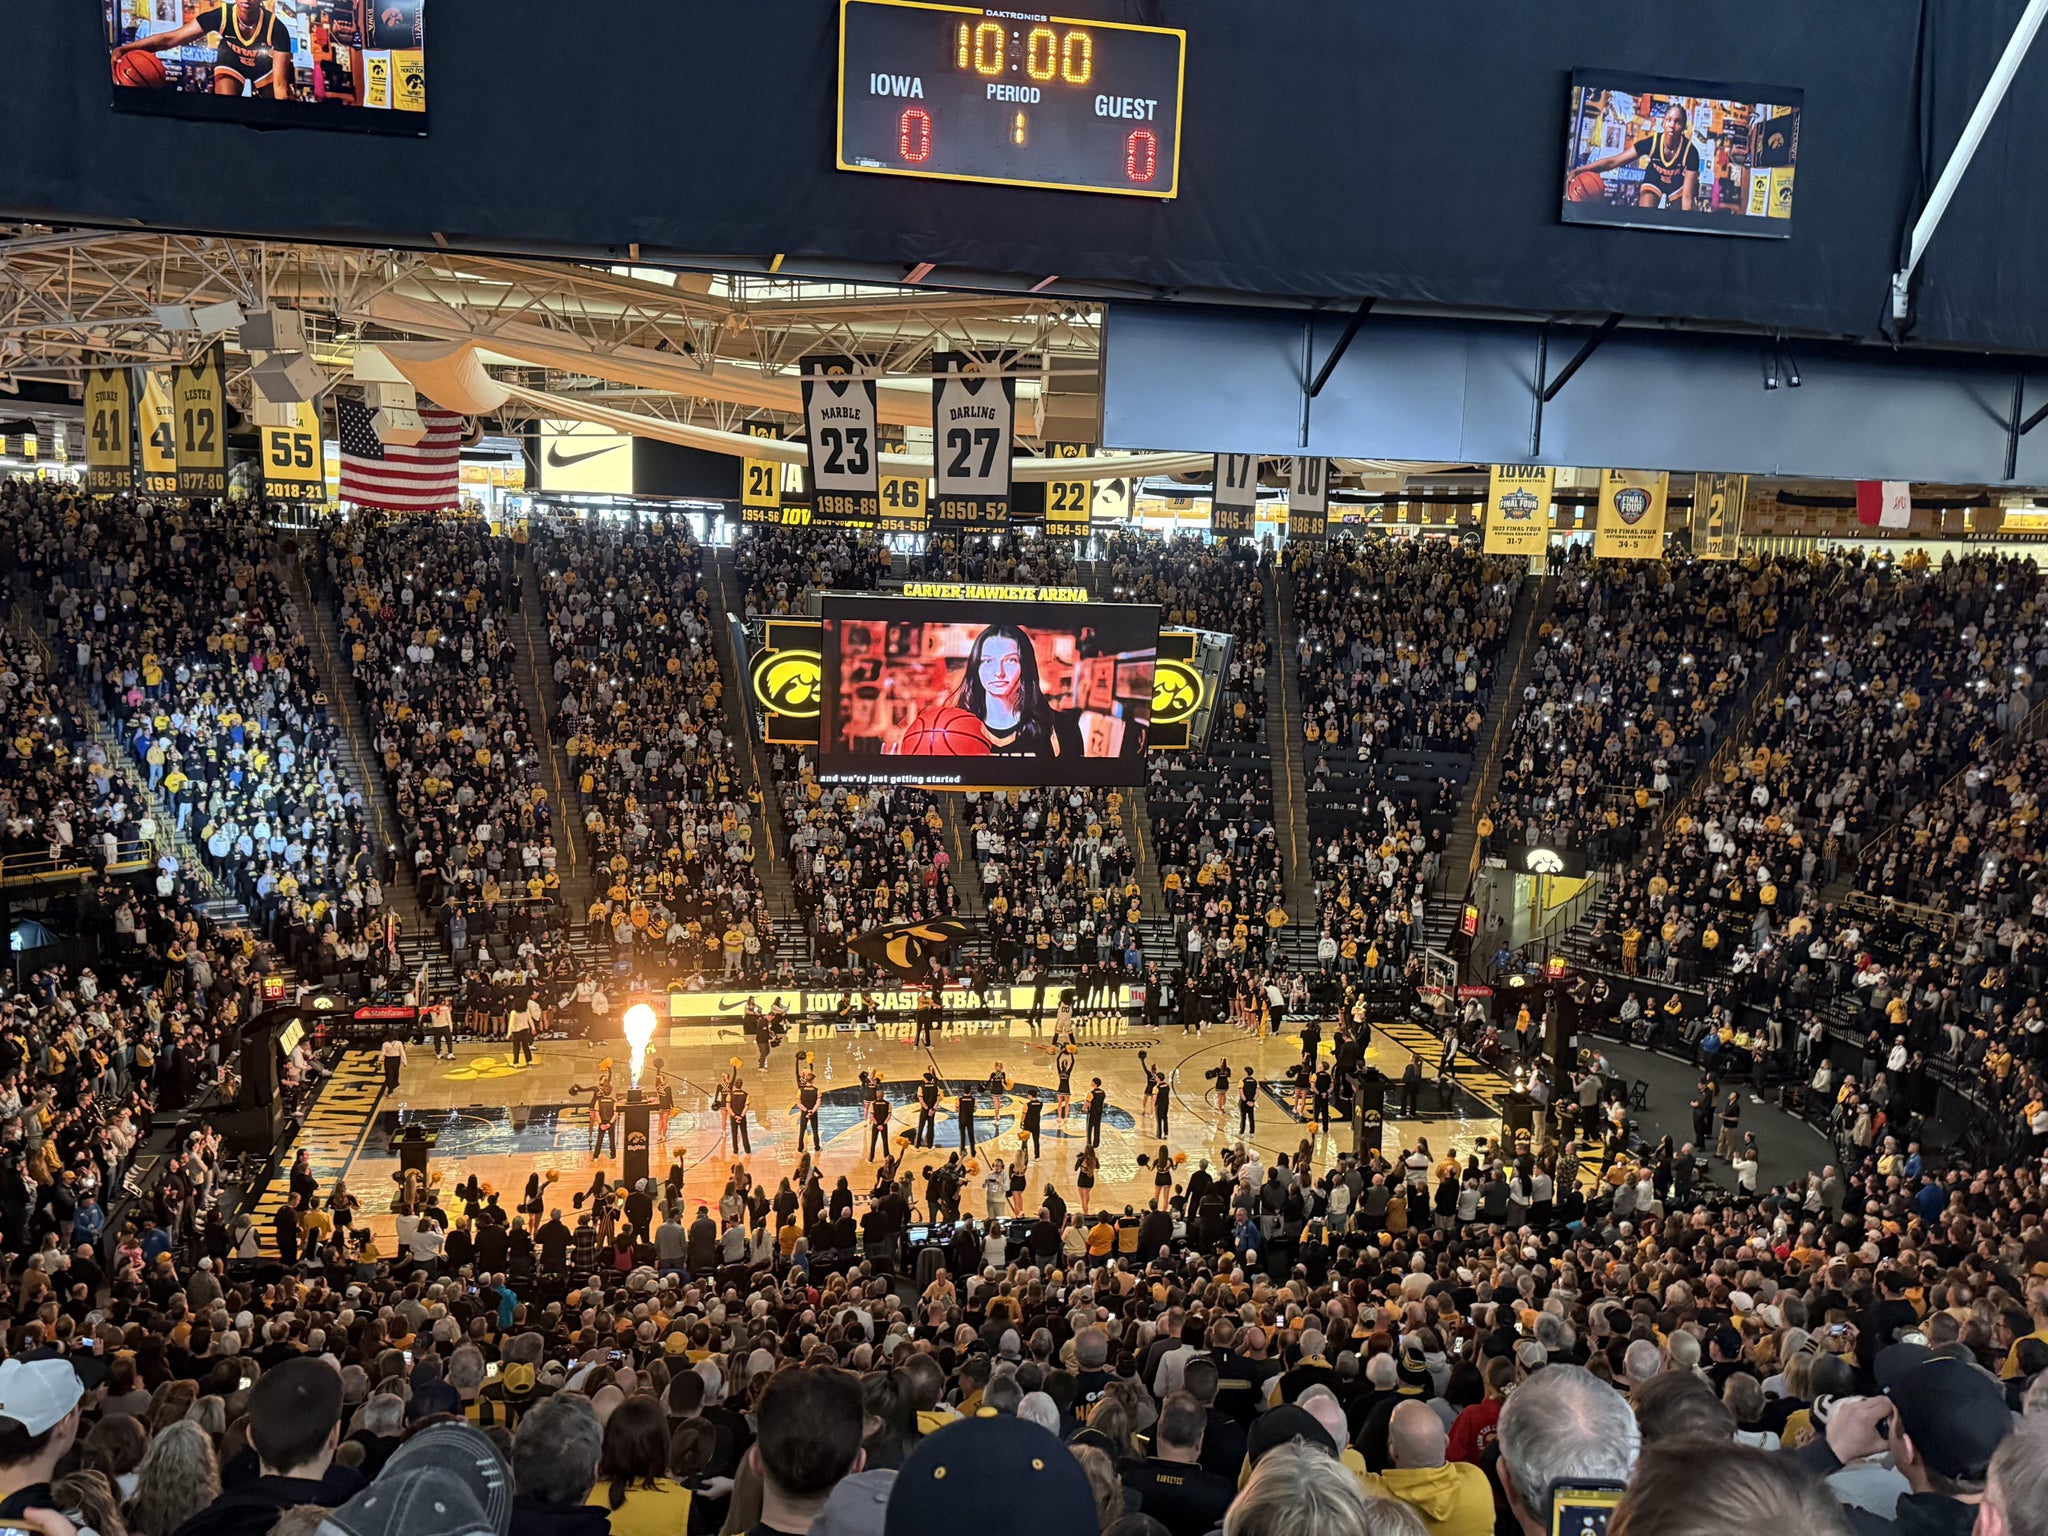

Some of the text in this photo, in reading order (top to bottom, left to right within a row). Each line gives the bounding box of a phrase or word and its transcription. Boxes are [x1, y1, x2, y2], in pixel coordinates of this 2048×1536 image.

[986, 9, 1047, 22] DAKTRONICS
[957, 21, 1093, 84] 10:00
[870, 73, 924, 99] IOWA
[986, 83, 1041, 104] PERIOD
[1095, 95, 1157, 121] GUEST
[900, 107, 931, 162] 0
[1014, 111, 1026, 145] 1
[1126, 129, 1157, 182] 0
[95, 391, 118, 402] STOKES
[184, 388, 211, 401] LESTER
[156, 406, 174, 415] STR
[821, 407, 861, 421] MARBLE
[950, 406, 996, 421] DARLING
[92, 409, 121, 451] 41
[183, 408, 215, 452] 12
[272, 431, 312, 468] 55
[820, 428, 869, 475] 23
[947, 428, 1000, 478] 27
[88, 471, 131, 488] 1982-85
[1498, 465, 1546, 478] IOWA
[146, 477, 176, 492] 199
[179, 473, 224, 490] 1977-80
[265, 483, 322, 499] 2018-21
[750, 466, 773, 497] 21
[883, 480, 919, 508] 46
[1051, 483, 1085, 511] 22
[1622, 495, 1643, 504] FINAL
[817, 496, 877, 515] 1986-89
[939, 501, 1007, 521] 1950-52
[1500, 499, 1538, 509] FINAL FOUR
[1621, 503, 1642, 513] FOUR
[742, 509, 779, 523] 1954-56
[1290, 515, 1324, 534] 1986-89
[1046, 523, 1089, 536] 1954-56
[903, 583, 1088, 602] CARVER-HAWKEYE ARENA
[868, 775, 888, 784] just
[890, 775, 923, 784] getting
[926, 775, 960, 783] started
